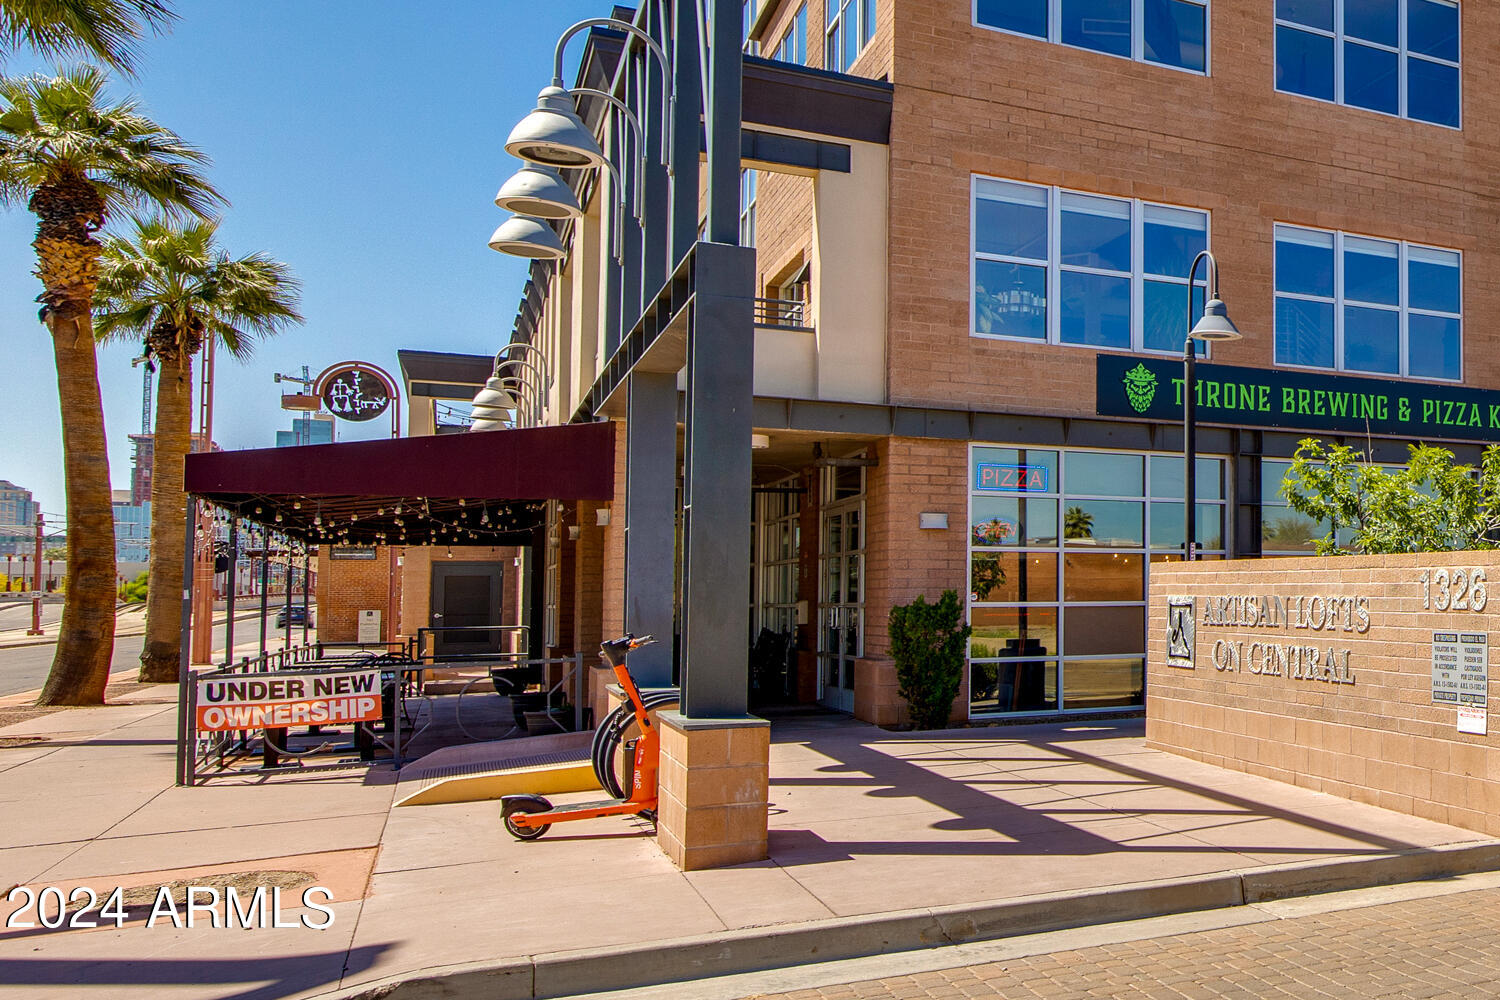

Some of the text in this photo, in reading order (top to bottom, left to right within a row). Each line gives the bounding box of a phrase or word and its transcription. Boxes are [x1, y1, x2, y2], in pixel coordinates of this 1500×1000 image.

[1282, 387, 1389, 421] BREWING
[1398, 397, 1411, 422] &
[1422, 399, 1482, 427] PIZZA
[982, 468, 1043, 487] PIZZA
[974, 522, 1017, 538] OPEN
[1419, 567, 1488, 613] 1326
[1202, 594, 1370, 633] ARTISAN LOFTS
[1211, 639, 1356, 685] ON CENTRAL
[206, 674, 375, 702] UNDER NEW
[203, 697, 376, 728] OWNERSHIP
